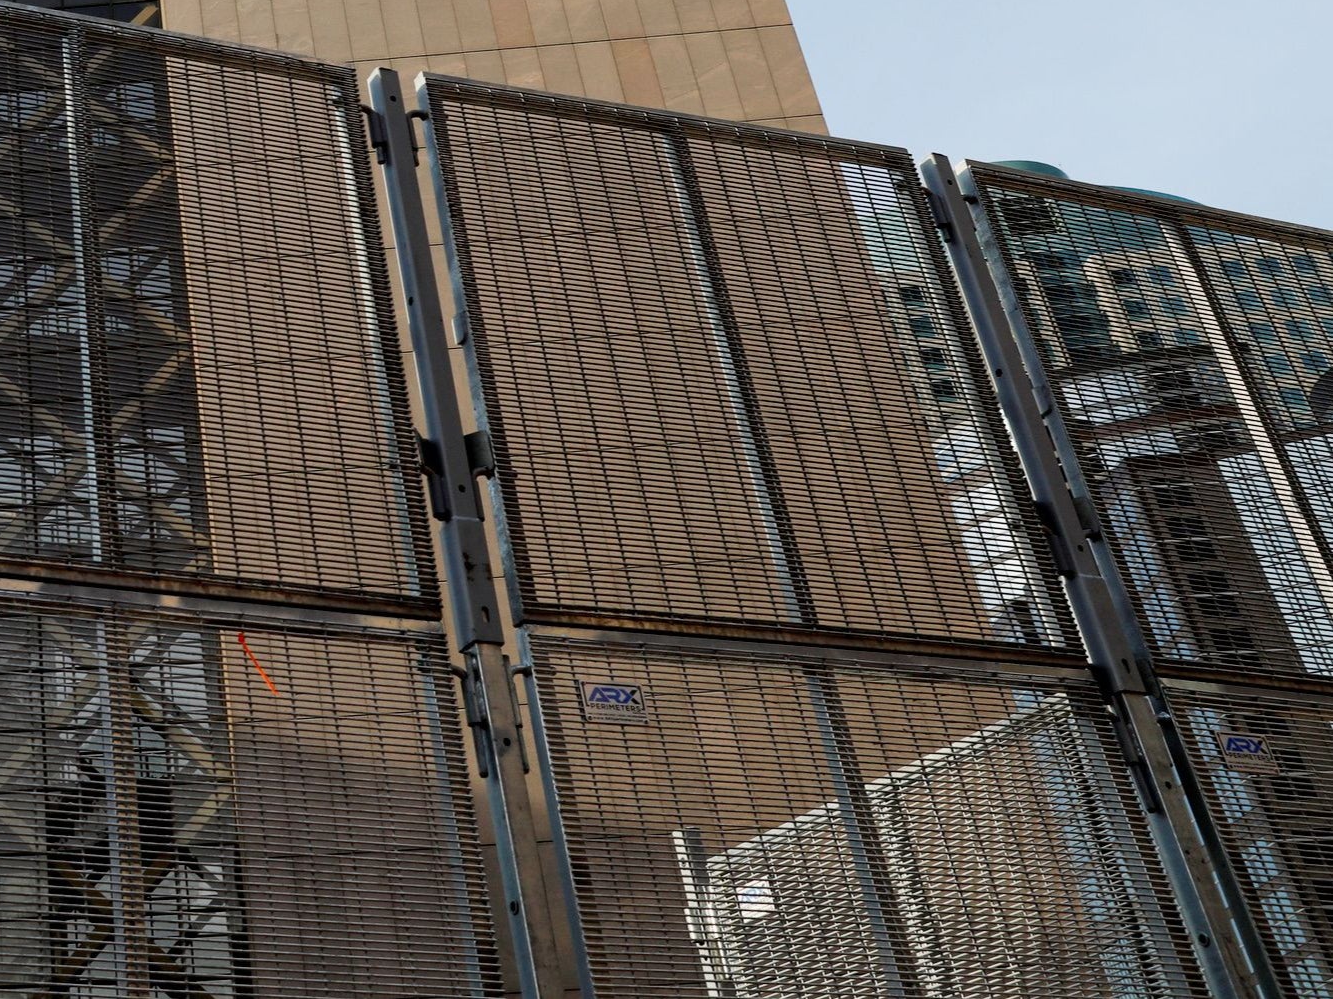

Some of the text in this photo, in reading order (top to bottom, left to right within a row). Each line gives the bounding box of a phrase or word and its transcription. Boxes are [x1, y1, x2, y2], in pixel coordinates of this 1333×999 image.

[588, 687, 641, 705] ARX
[590, 703, 641, 713] PERIMETERS
[1226, 738, 1268, 754] ARX
